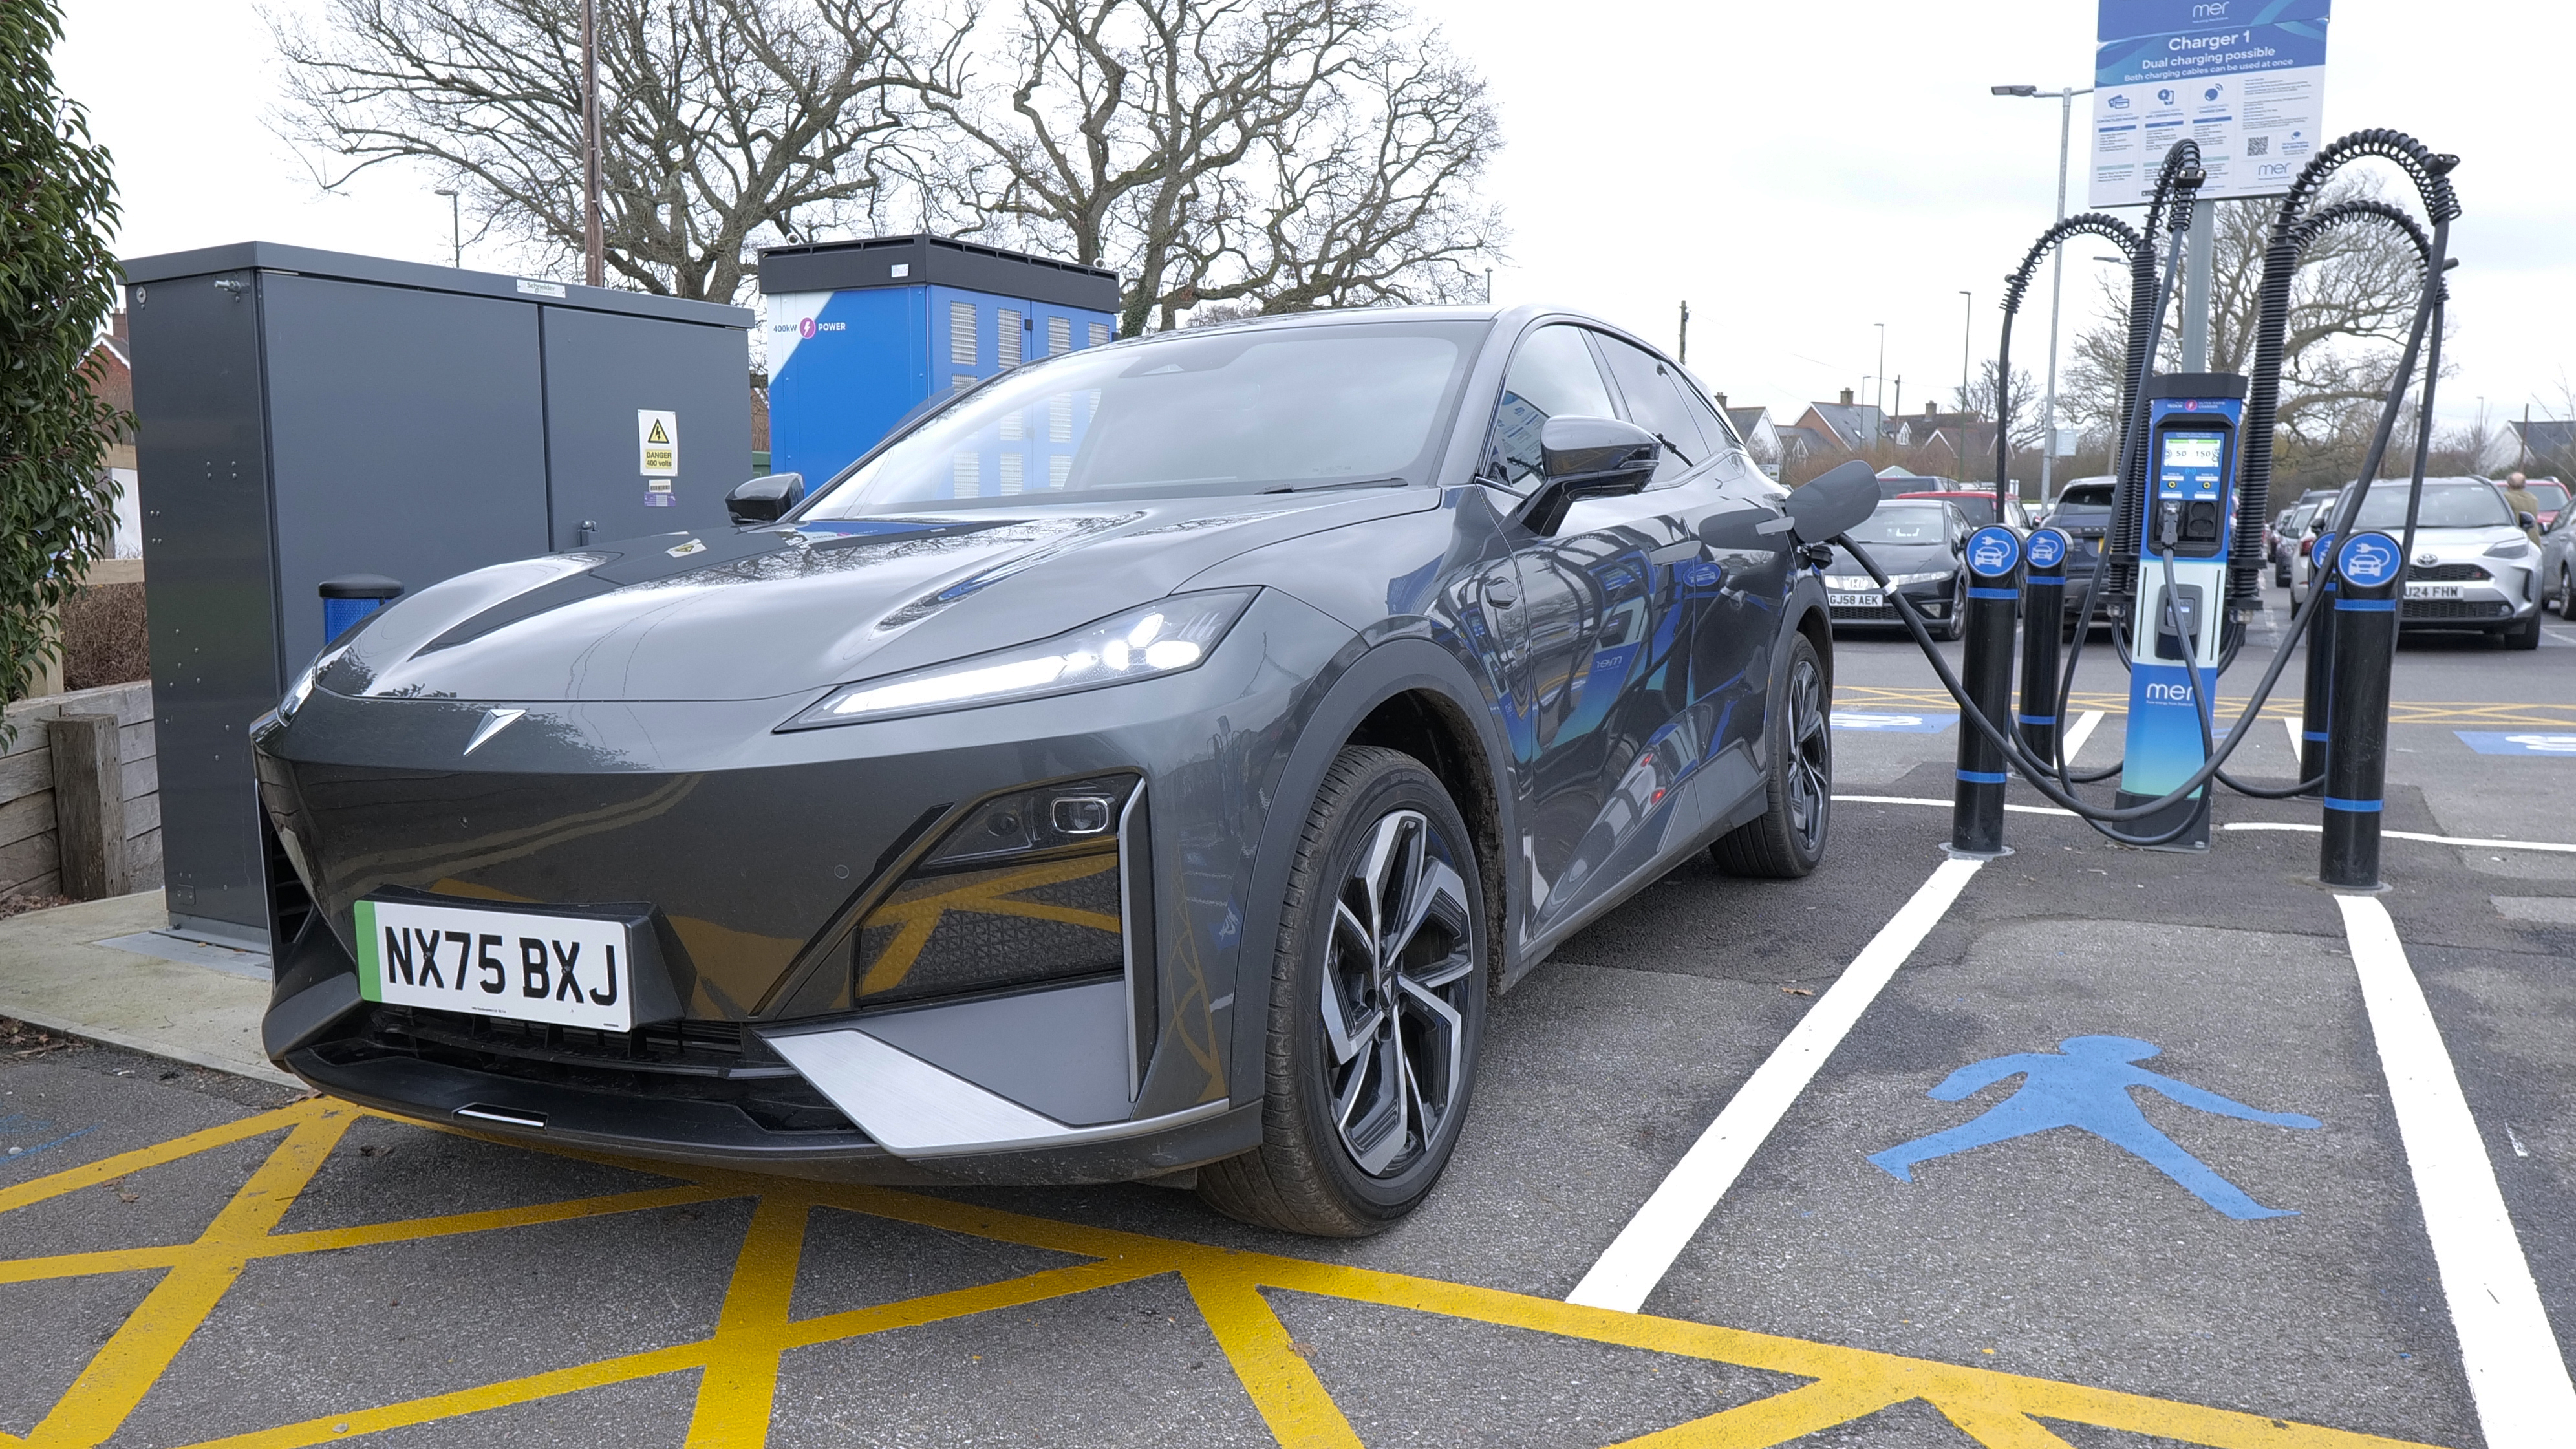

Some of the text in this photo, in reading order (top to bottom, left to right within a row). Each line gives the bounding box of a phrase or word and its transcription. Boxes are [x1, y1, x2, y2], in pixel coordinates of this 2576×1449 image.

[2192, 1, 2230, 17] mer
[2168, 30, 2250, 51] Charger 1
[2142, 47, 2276, 70] Dual charging possible
[2124, 73, 2143, 81] Both
[2145, 70, 2180, 80] charging
[2182, 67, 2209, 76] cables
[2239, 61, 2260, 70] used
[2258, 162, 2292, 175] mer
[527, 281, 556, 292] Schneider
[773, 322, 846, 332] 400kW POWER
[2404, 586, 2458, 597] U24 FHW
[1829, 595, 1878, 605] GJ58 AEK
[2147, 683, 2193, 701] mer
[385, 926, 618, 1007] NX75 BXJ
